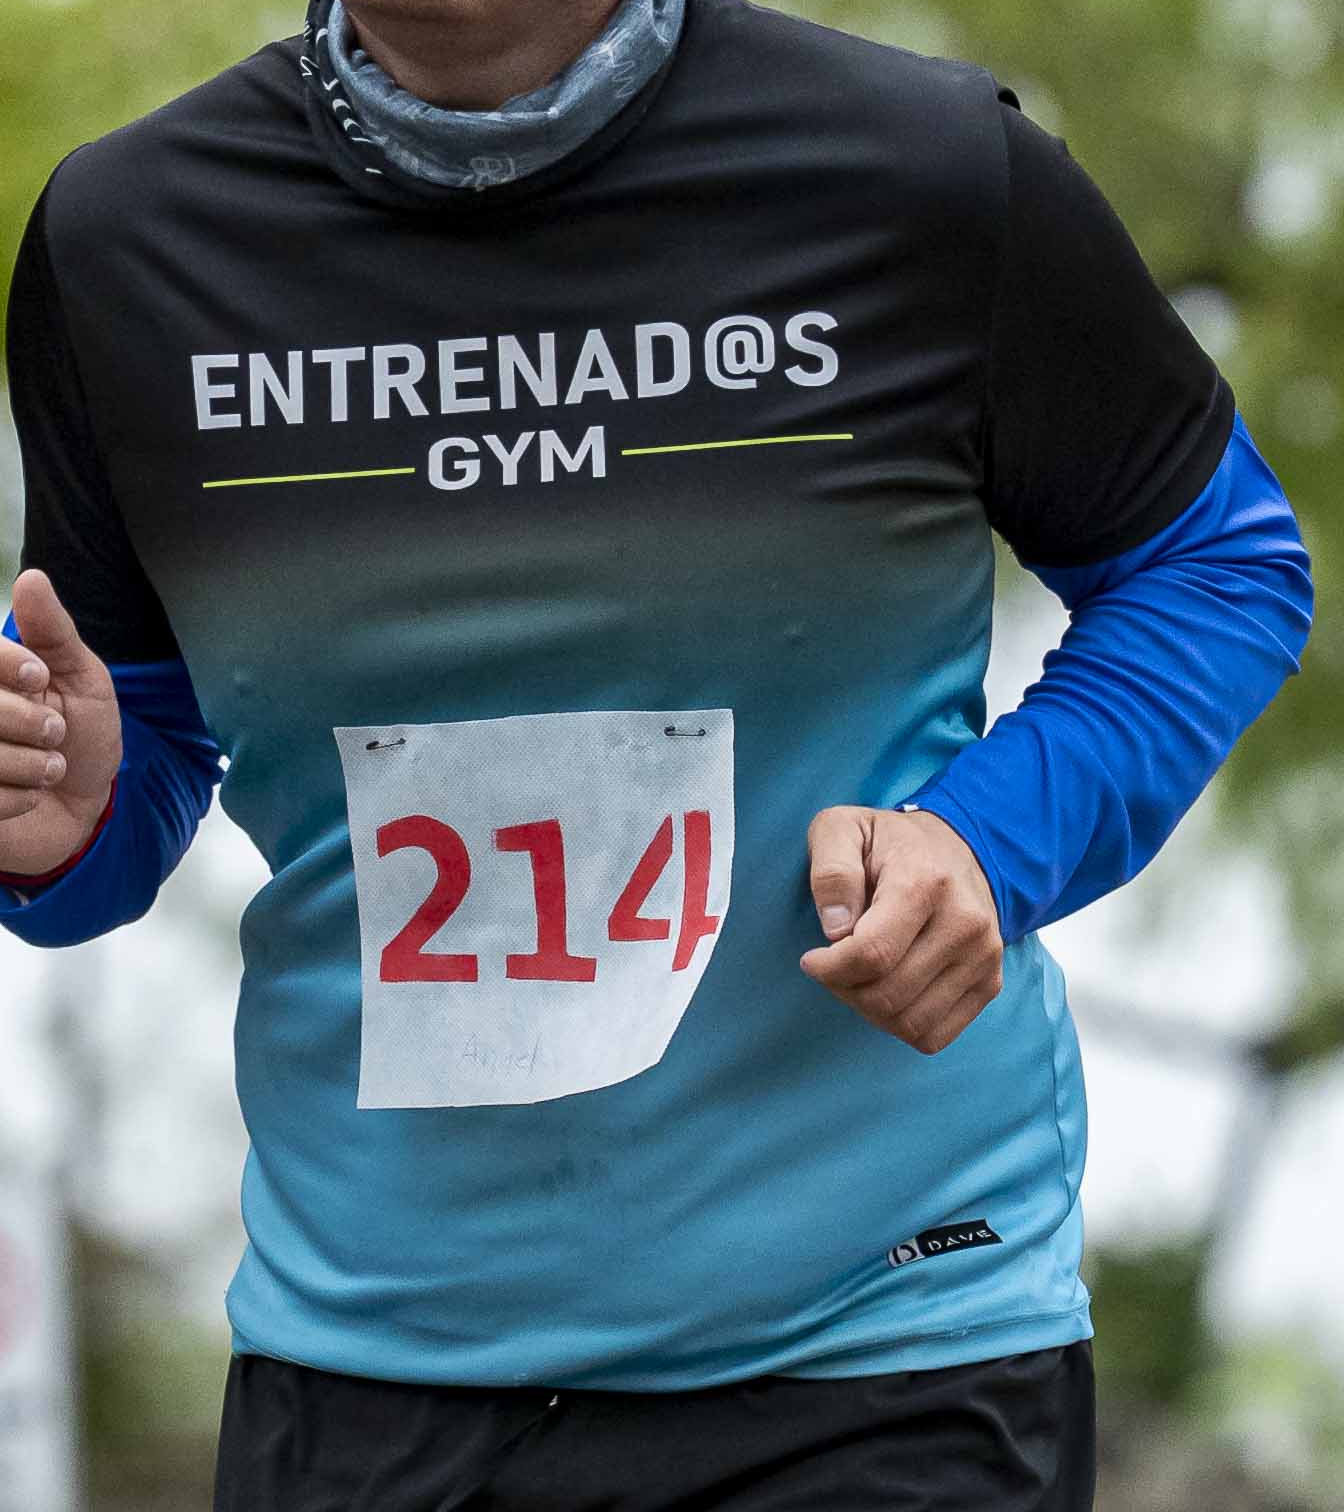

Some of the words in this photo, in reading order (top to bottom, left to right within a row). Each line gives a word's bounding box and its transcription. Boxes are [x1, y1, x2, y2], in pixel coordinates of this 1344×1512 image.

[190, 311, 840, 430] ENTRENAD@S
[427, 425, 607, 491] GYM
[375, 809, 721, 983] 214
